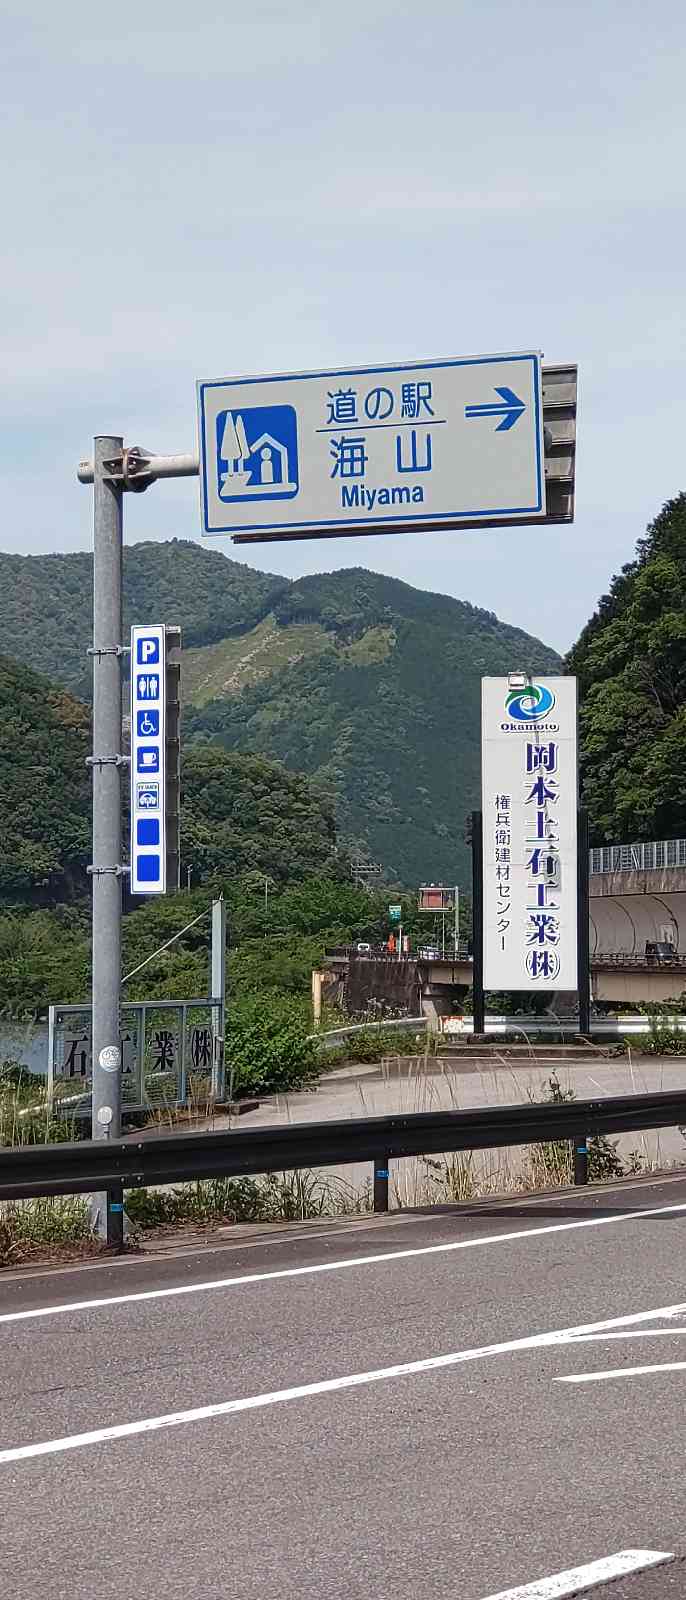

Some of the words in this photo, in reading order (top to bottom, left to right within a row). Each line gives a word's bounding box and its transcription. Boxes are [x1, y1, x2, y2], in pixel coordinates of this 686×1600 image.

[326, 382, 435, 424] 道の駅
[330, 430, 432, 478] 海山
[341, 484, 424, 510] Miyama
[142, 641, 156, 662] P
[500, 722, 559, 732] Okamoto
[495, 794, 512, 951] 権兵衛建材センター
